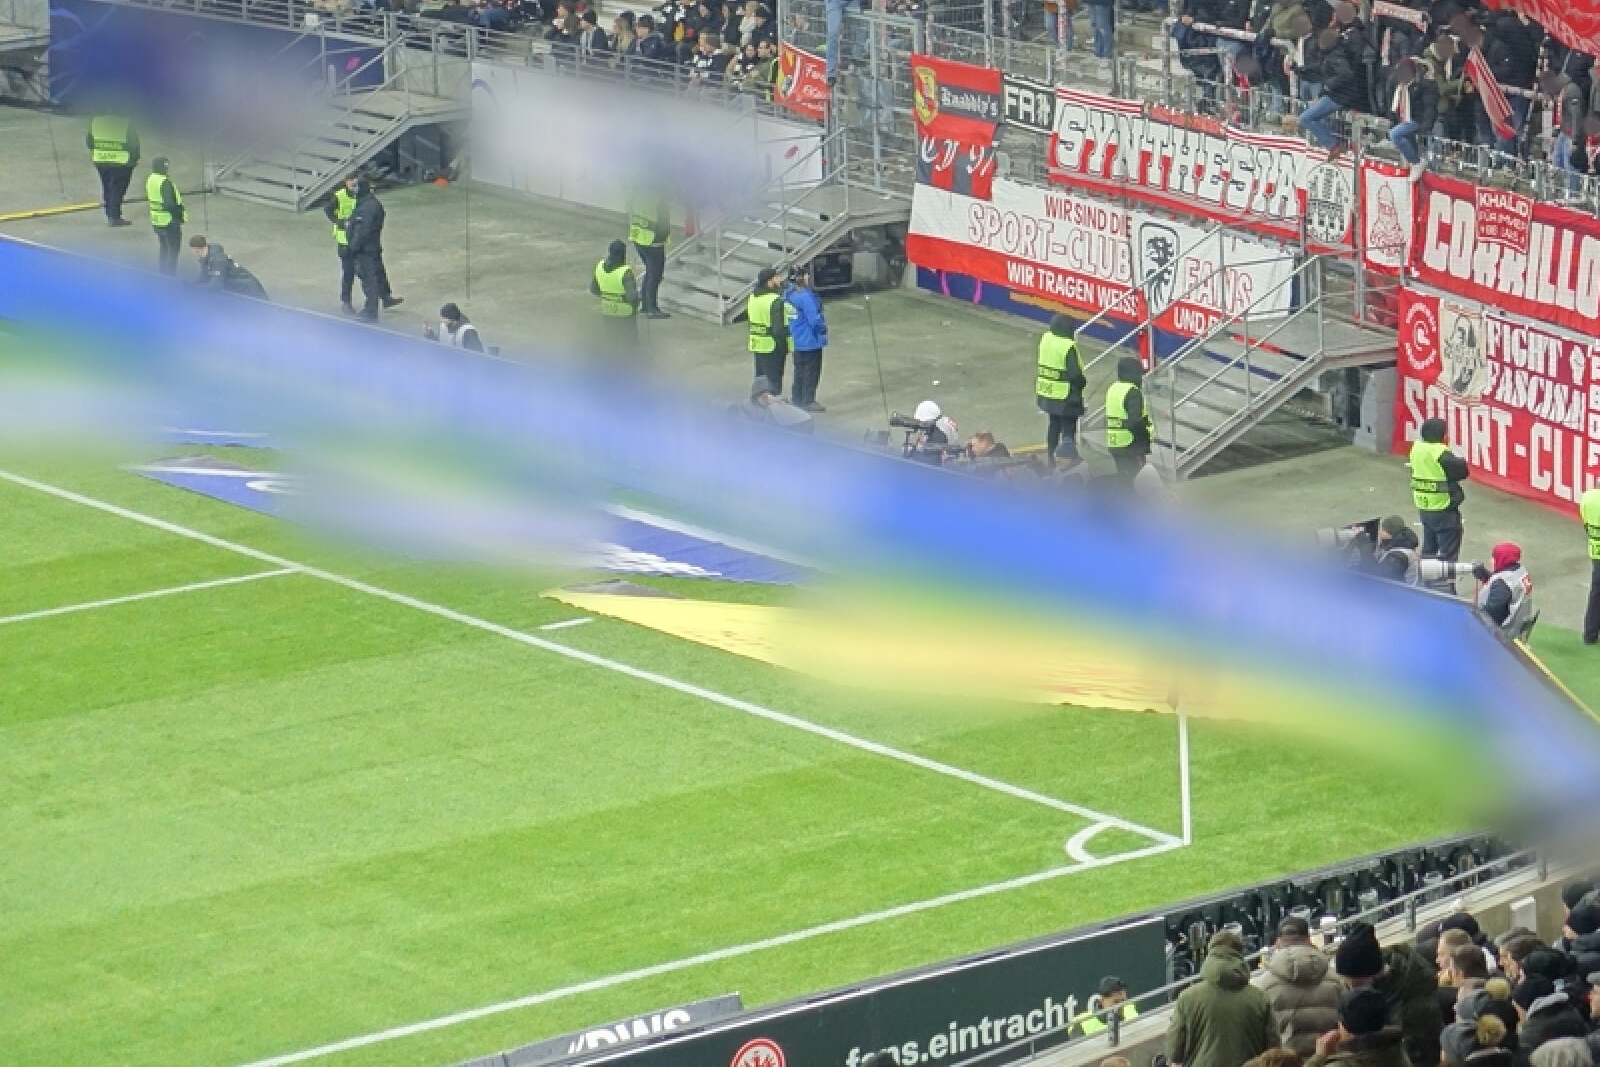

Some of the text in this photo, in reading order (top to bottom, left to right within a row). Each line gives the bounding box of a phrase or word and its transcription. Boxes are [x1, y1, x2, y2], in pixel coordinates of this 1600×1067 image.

[1055, 102, 1299, 221] SYNTHESIA
[967, 202, 1134, 284] SPORT-CLUB
[1043, 194, 1133, 238] WIR SIND DIE
[1007, 260, 1035, 287] WIR
[1037, 269, 1096, 305] TRAGEN
[1485, 317, 1562, 379] FIGHT
